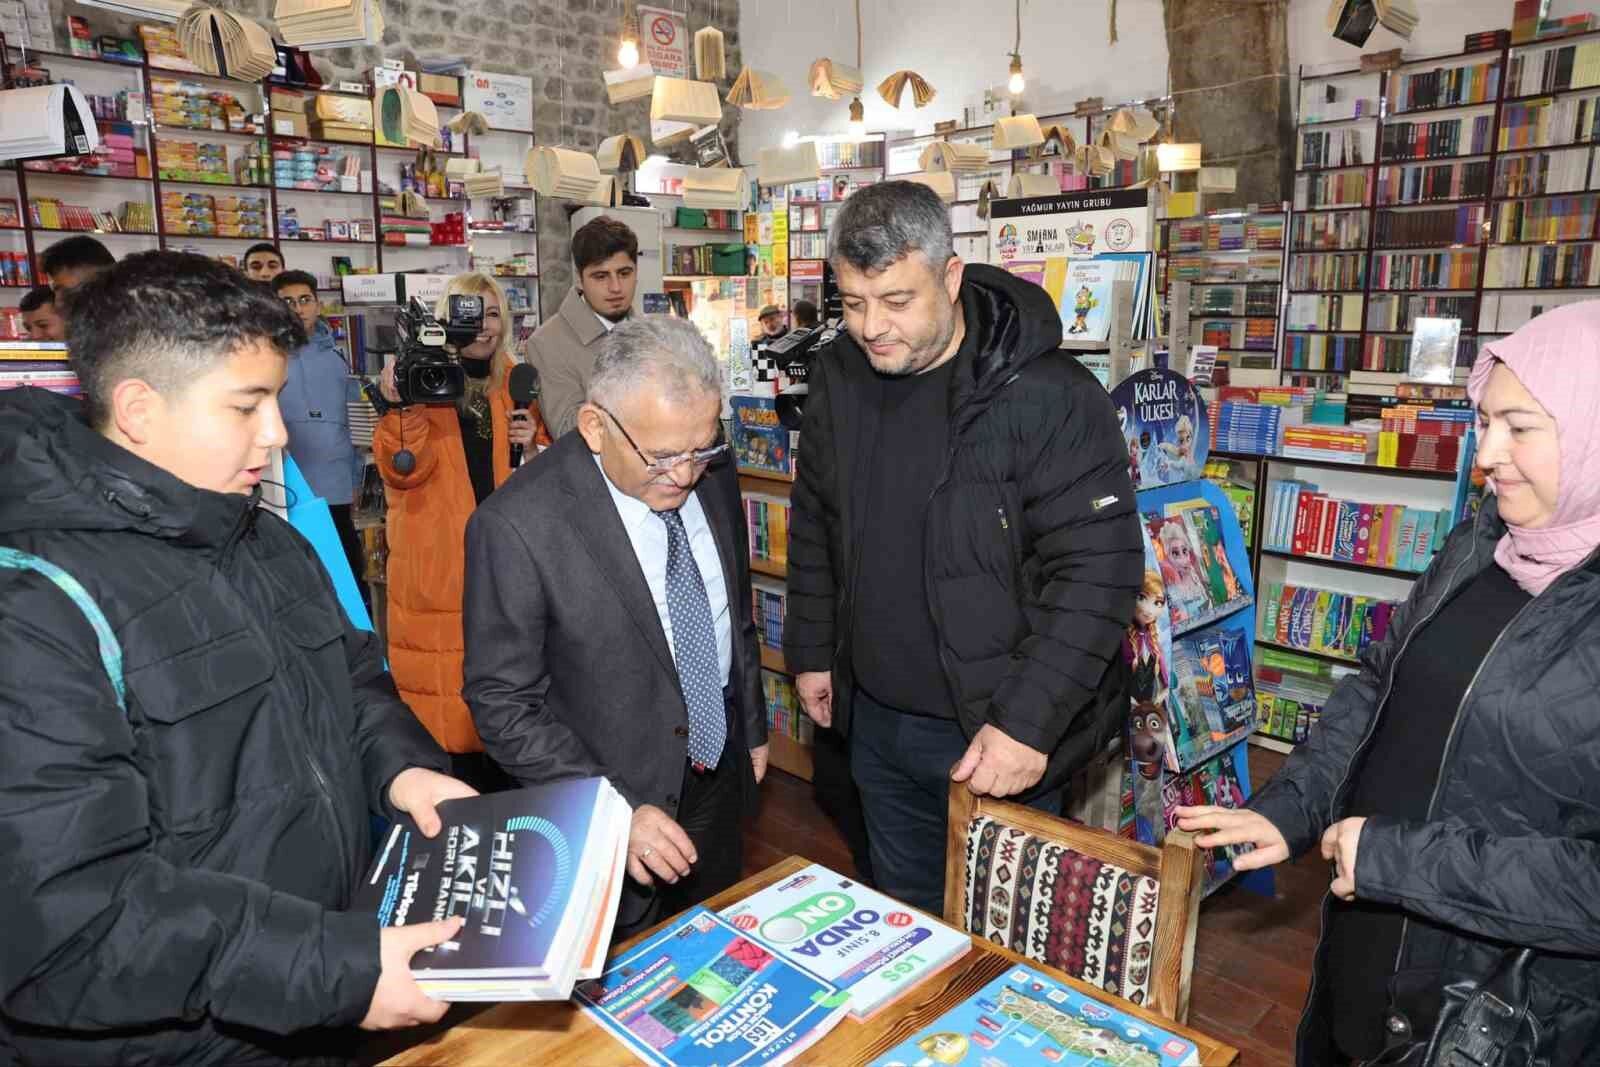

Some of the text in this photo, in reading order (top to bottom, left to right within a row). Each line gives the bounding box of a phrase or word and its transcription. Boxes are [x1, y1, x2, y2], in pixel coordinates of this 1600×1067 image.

[1021, 197, 1112, 214] YAĞMUR YAYIN GRUBU
[1134, 380, 1179, 404] KARLAR
[1141, 403, 1174, 422] ÜLKESİ
[443, 825, 459, 872] SORU
[437, 824, 480, 951] AKILI
[480, 832, 513, 936] HIZLI
[794, 894, 846, 924] ON
[791, 909, 880, 958] ONDA
[880, 953, 927, 983] LGS
[694, 981, 778, 1048] KONTROL
[744, 1018, 773, 1044] LGS
